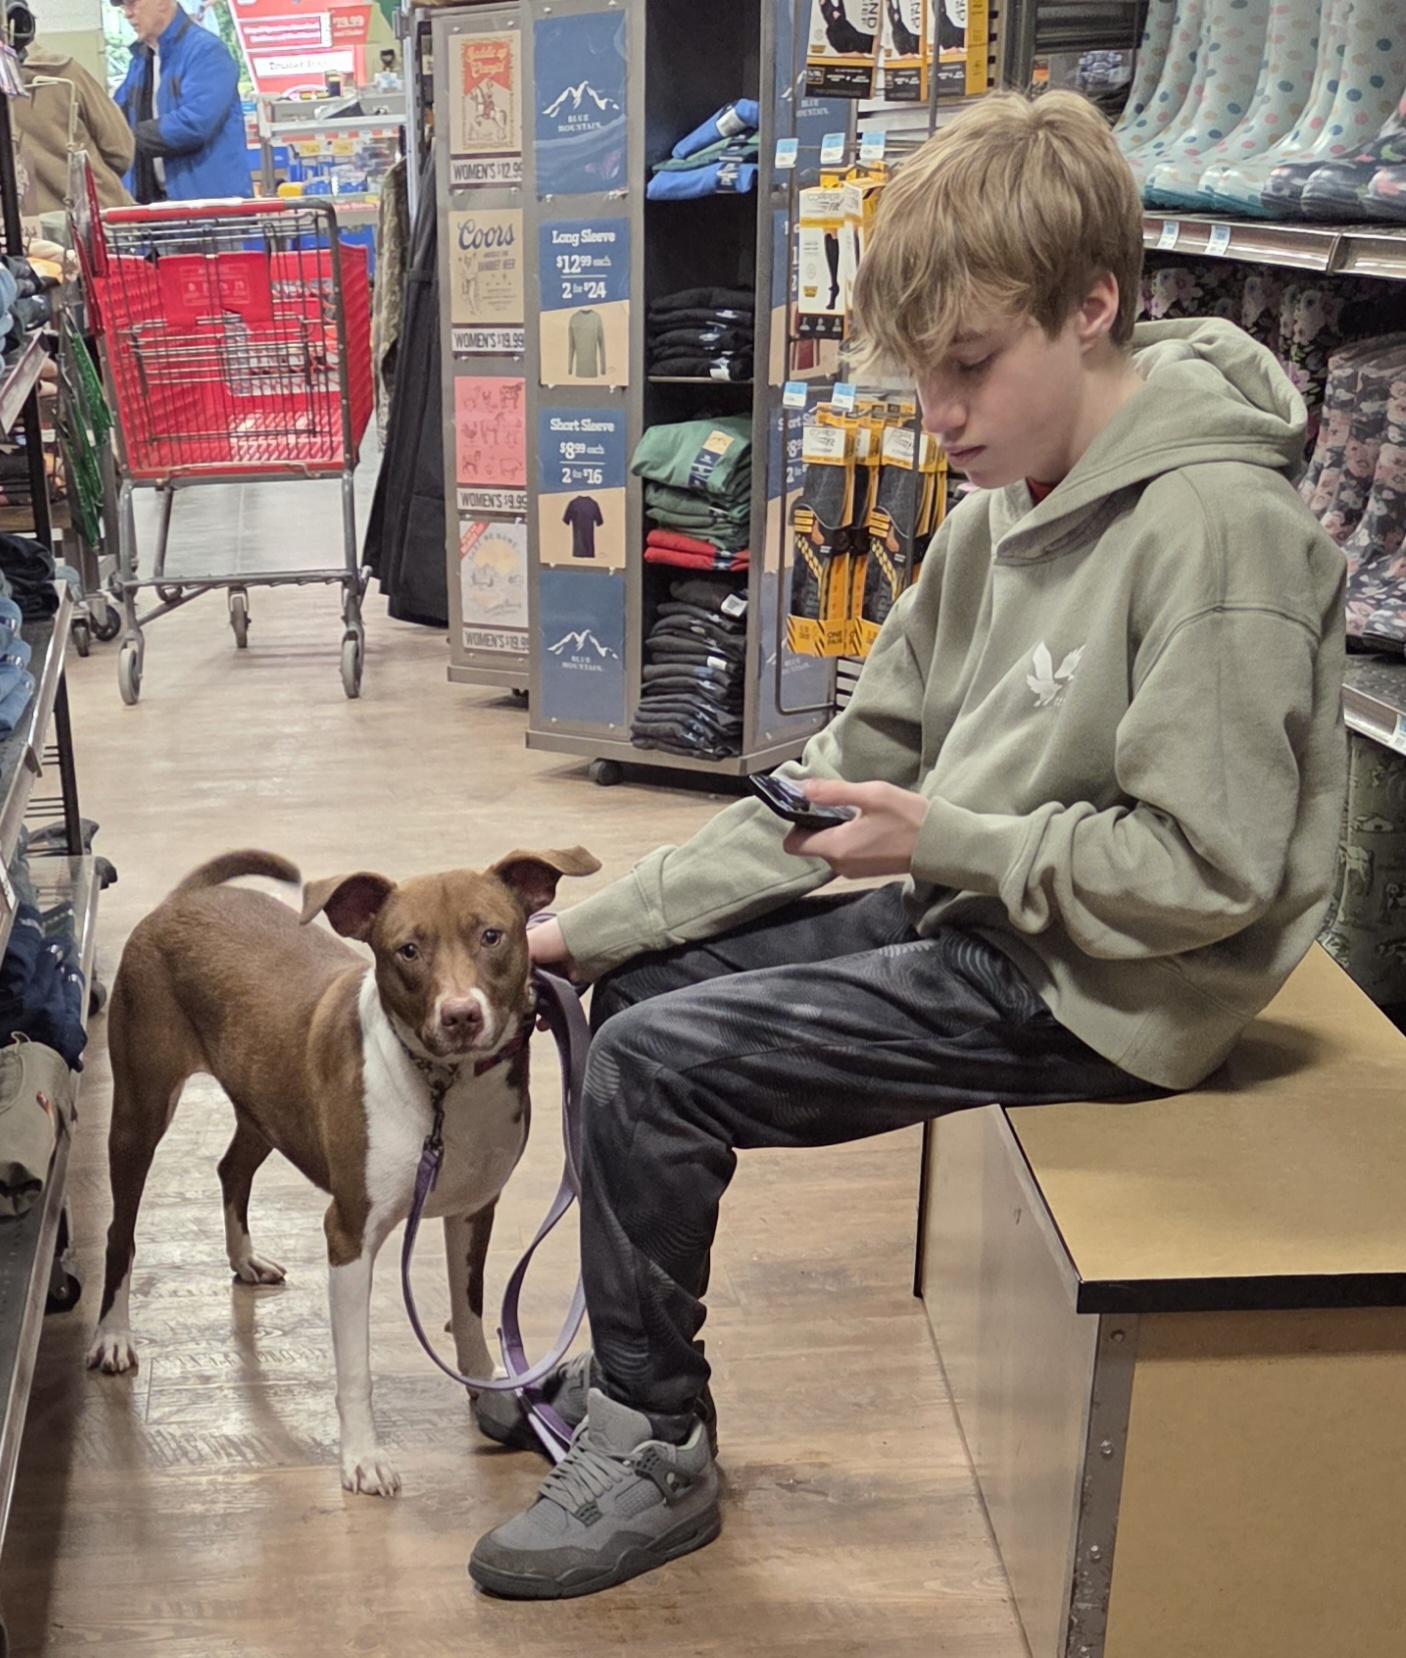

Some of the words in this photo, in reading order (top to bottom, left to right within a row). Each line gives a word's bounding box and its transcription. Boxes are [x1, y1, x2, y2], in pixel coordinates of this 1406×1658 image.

[568, 114, 589, 123] BLUE
[454, 163, 495, 180] WOMEN'S
[457, 219, 515, 250] Coors
[551, 230, 580, 247] Long
[580, 228, 616, 243] Sleeve
[592, 256, 612, 266] each
[562, 282, 573, 299] 2
[573, 283, 583, 293] for
[583, 281, 607, 298] $24
[455, 333, 496, 348] WOMEN'S
[550, 417, 580, 432] Short
[580, 418, 615, 432] Sleeve
[587, 444, 605, 455] each
[562, 467, 572, 484] 2
[572, 469, 582, 478] for
[583, 468, 603, 484] $16
[461, 492, 502, 509] WOMEN'S
[465, 631, 504, 649] WOMEN'S
